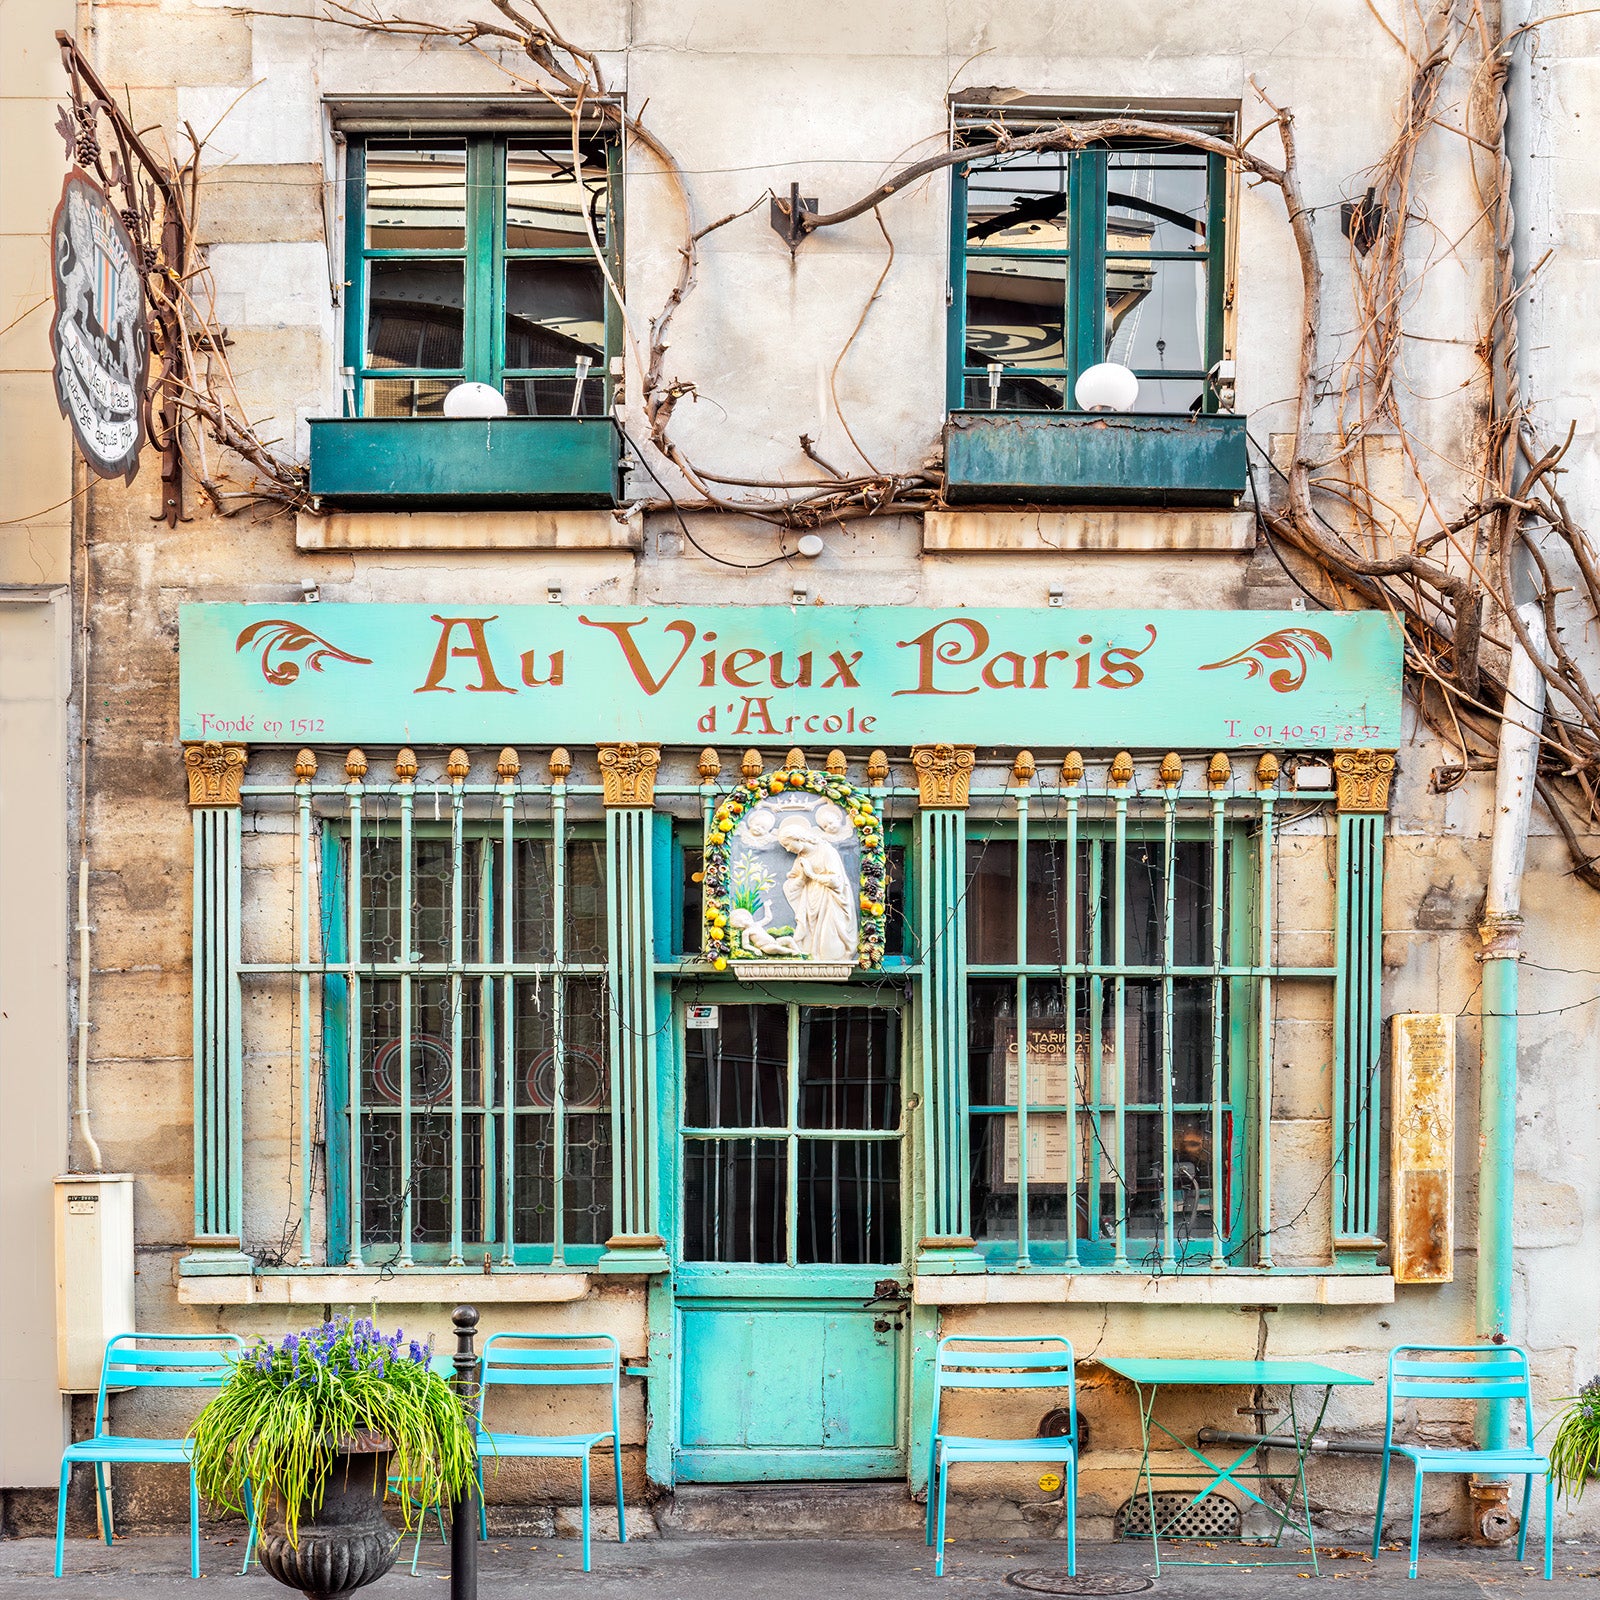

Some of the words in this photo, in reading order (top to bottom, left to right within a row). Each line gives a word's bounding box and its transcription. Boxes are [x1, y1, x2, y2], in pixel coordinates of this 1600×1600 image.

[64, 365, 93, 431] Auberge
[95, 427, 118, 453] depuis
[413, 614, 564, 694] Au
[577, 615, 863, 697] Vieux
[891, 618, 1157, 697] Paris
[198, 712, 255, 738] Fondé
[263, 720, 282, 738] en
[289, 718, 325, 736] 1512
[697, 695, 877, 735] d'Arcole
[1224, 719, 1242, 738] T.
[1253, 725, 1273, 737] 01
[1280, 725, 1303, 741] 40
[1310, 725, 1327, 741] 51
[1358, 725, 1380, 743] 52
